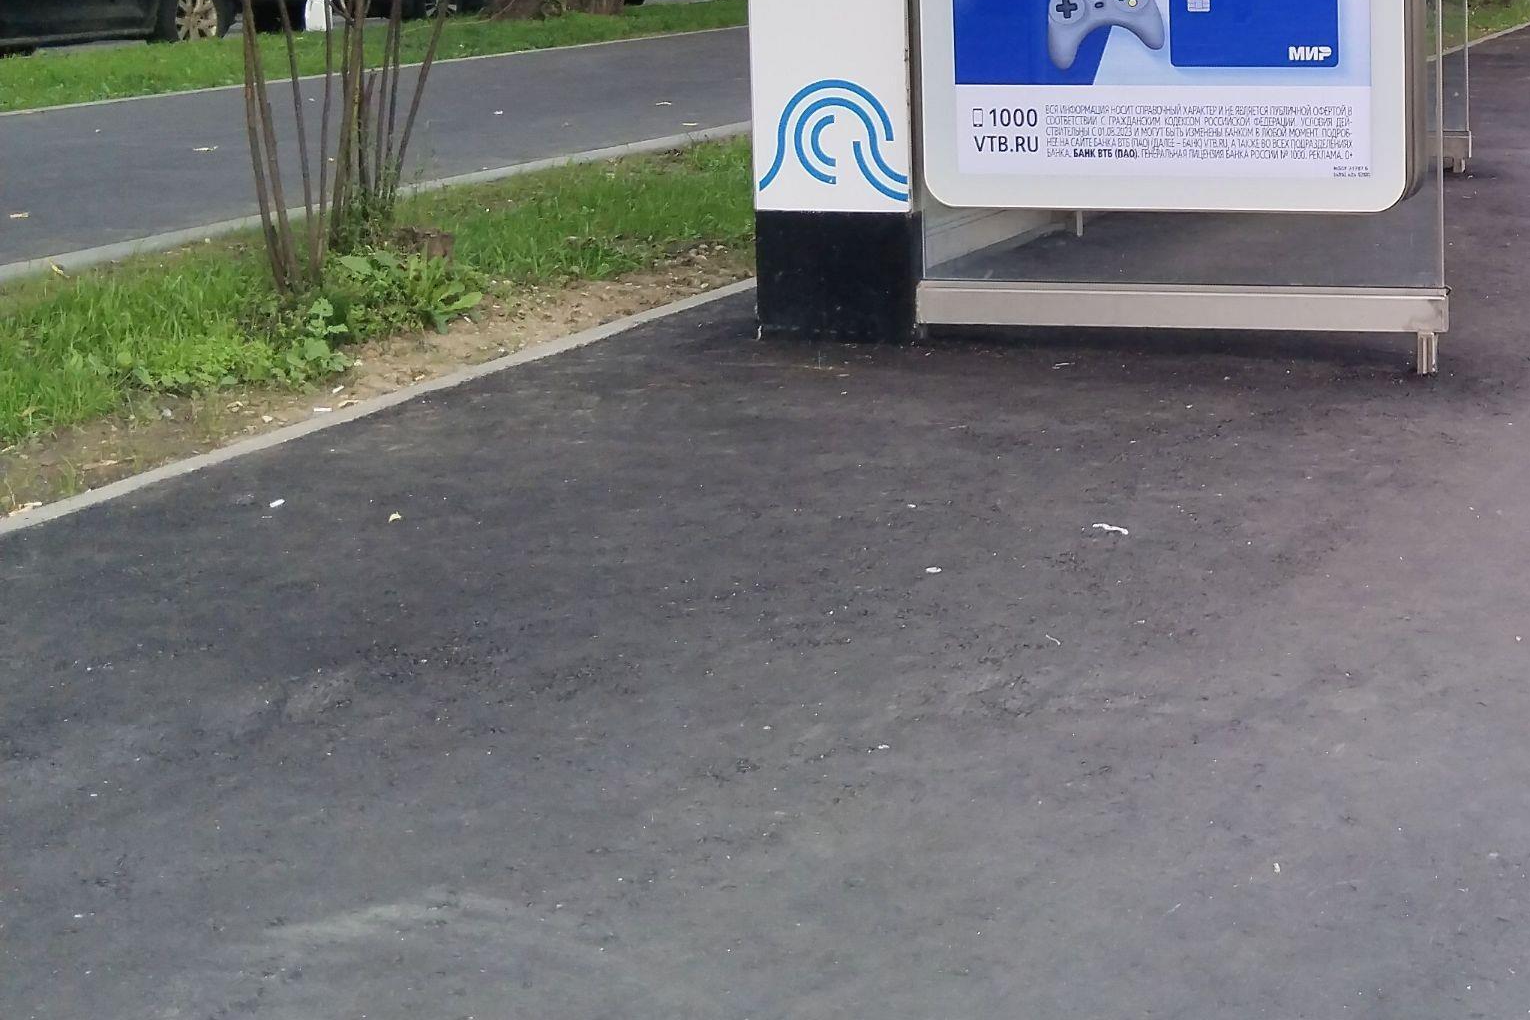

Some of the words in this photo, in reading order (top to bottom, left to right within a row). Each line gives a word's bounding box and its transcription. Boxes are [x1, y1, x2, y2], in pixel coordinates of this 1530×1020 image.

[1288, 45, 1332, 61] МИР
[989, 108, 1038, 127] 1000
[973, 135, 1039, 153] VTB.RU
[1073, 148, 1096, 158] БАНК
[1097, 148, 1113, 158] ВТБ
